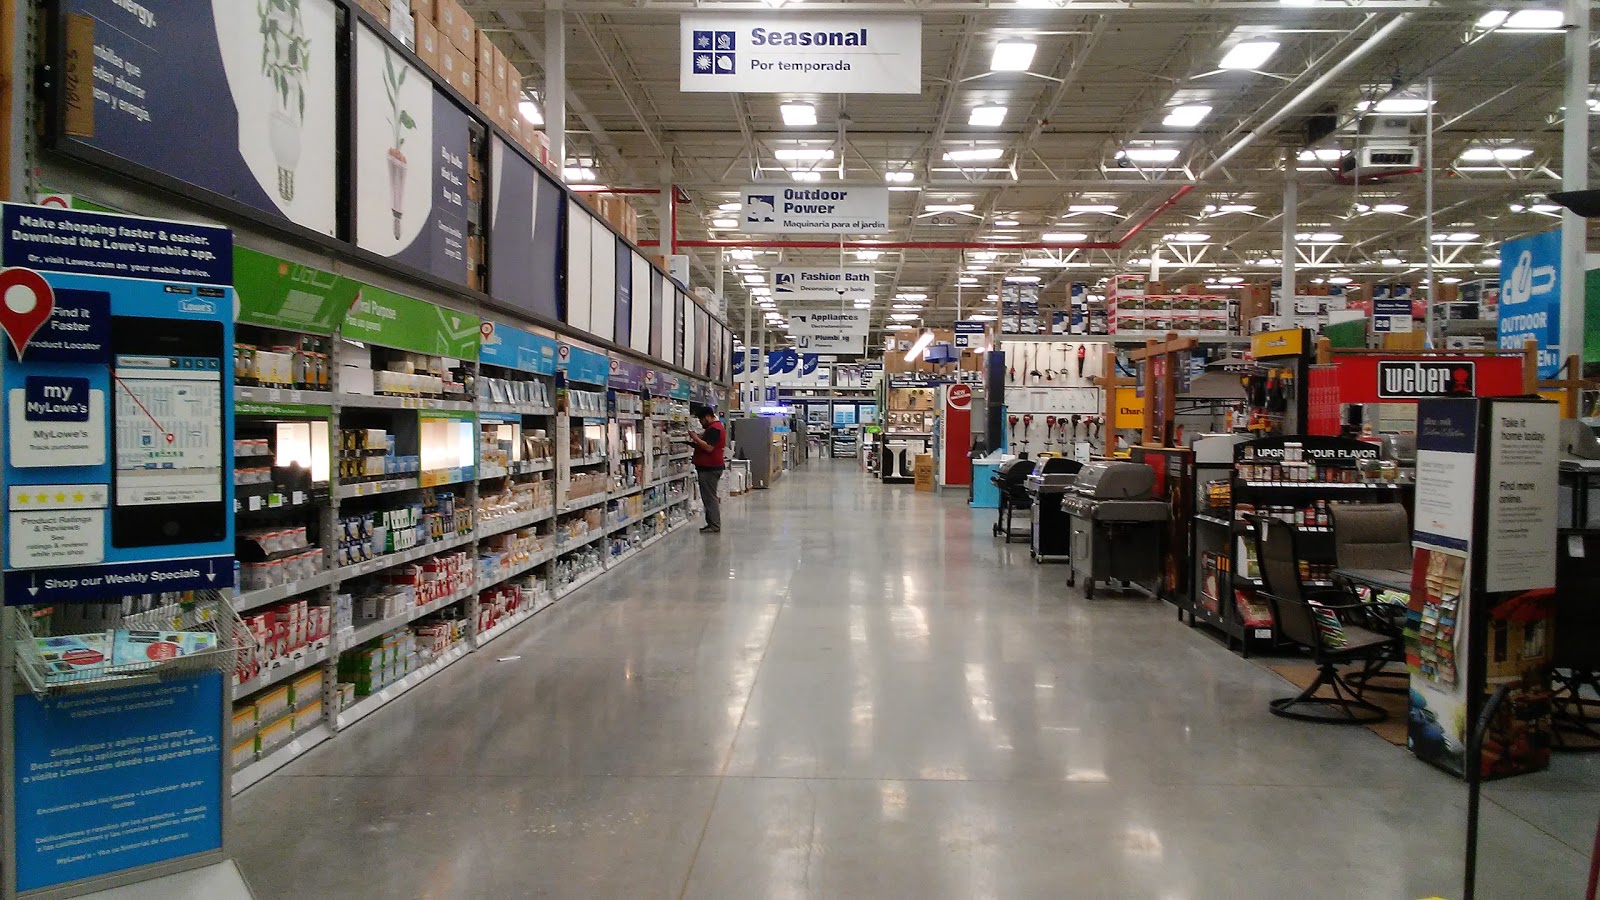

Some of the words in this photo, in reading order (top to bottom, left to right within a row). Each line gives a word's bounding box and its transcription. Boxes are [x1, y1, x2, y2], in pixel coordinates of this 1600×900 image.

[751, 27, 867, 46] Seasonal
[751, 59, 773, 71] Por
[778, 59, 851, 73] temporada
[784, 188, 848, 200] Outdoor
[784, 202, 835, 214] Power
[783, 220, 830, 228] Maquinaria
[20, 215, 55, 229] Make
[58, 219, 117, 238] shopping
[118, 227, 156, 240] faster
[157, 230, 168, 240] &
[170, 232, 210, 246] easier.
[12, 230, 77, 247] Download
[79, 237, 101, 248] the
[103, 239, 146, 252] Lowe's
[148, 243, 189, 258] mobile
[190, 249, 216, 261] app.
[45, 255, 65, 265] visit
[65, 257, 115, 270] Lowes.com
[130, 262, 151, 274] your
[152, 264, 181, 275] mobile
[181, 267, 210, 278] device.
[801, 272, 841, 281] Fashion
[845, 273, 870, 281] Bath
[52, 307, 78, 317] Find
[81, 308, 90, 318] it
[811, 313, 858, 321] Appliances
[51, 321, 91, 332] Faster
[1501, 312, 1547, 333] OUTDOOR
[64, 341, 101, 350] Locator
[956, 337, 968, 345] 29
[1385, 363, 1451, 393] weber
[44, 385, 73, 400] my
[27, 402, 88, 414] MyLowe's
[1501, 417, 1519, 428] Take
[1520, 418, 1526, 428] it
[33, 430, 88, 439] MyLowe's
[1501, 431, 1522, 440] home
[1338, 450, 1376, 458] FLAVOR
[1500, 481, 1515, 490] Find
[21, 516, 57, 526] Product
[58, 516, 92, 526] Ratings
[42, 524, 80, 532] Reviews
[45, 578, 78, 590] Shop
[81, 578, 103, 587] our
[105, 572, 148, 586] Weekly
[150, 569, 200, 583] Specials
